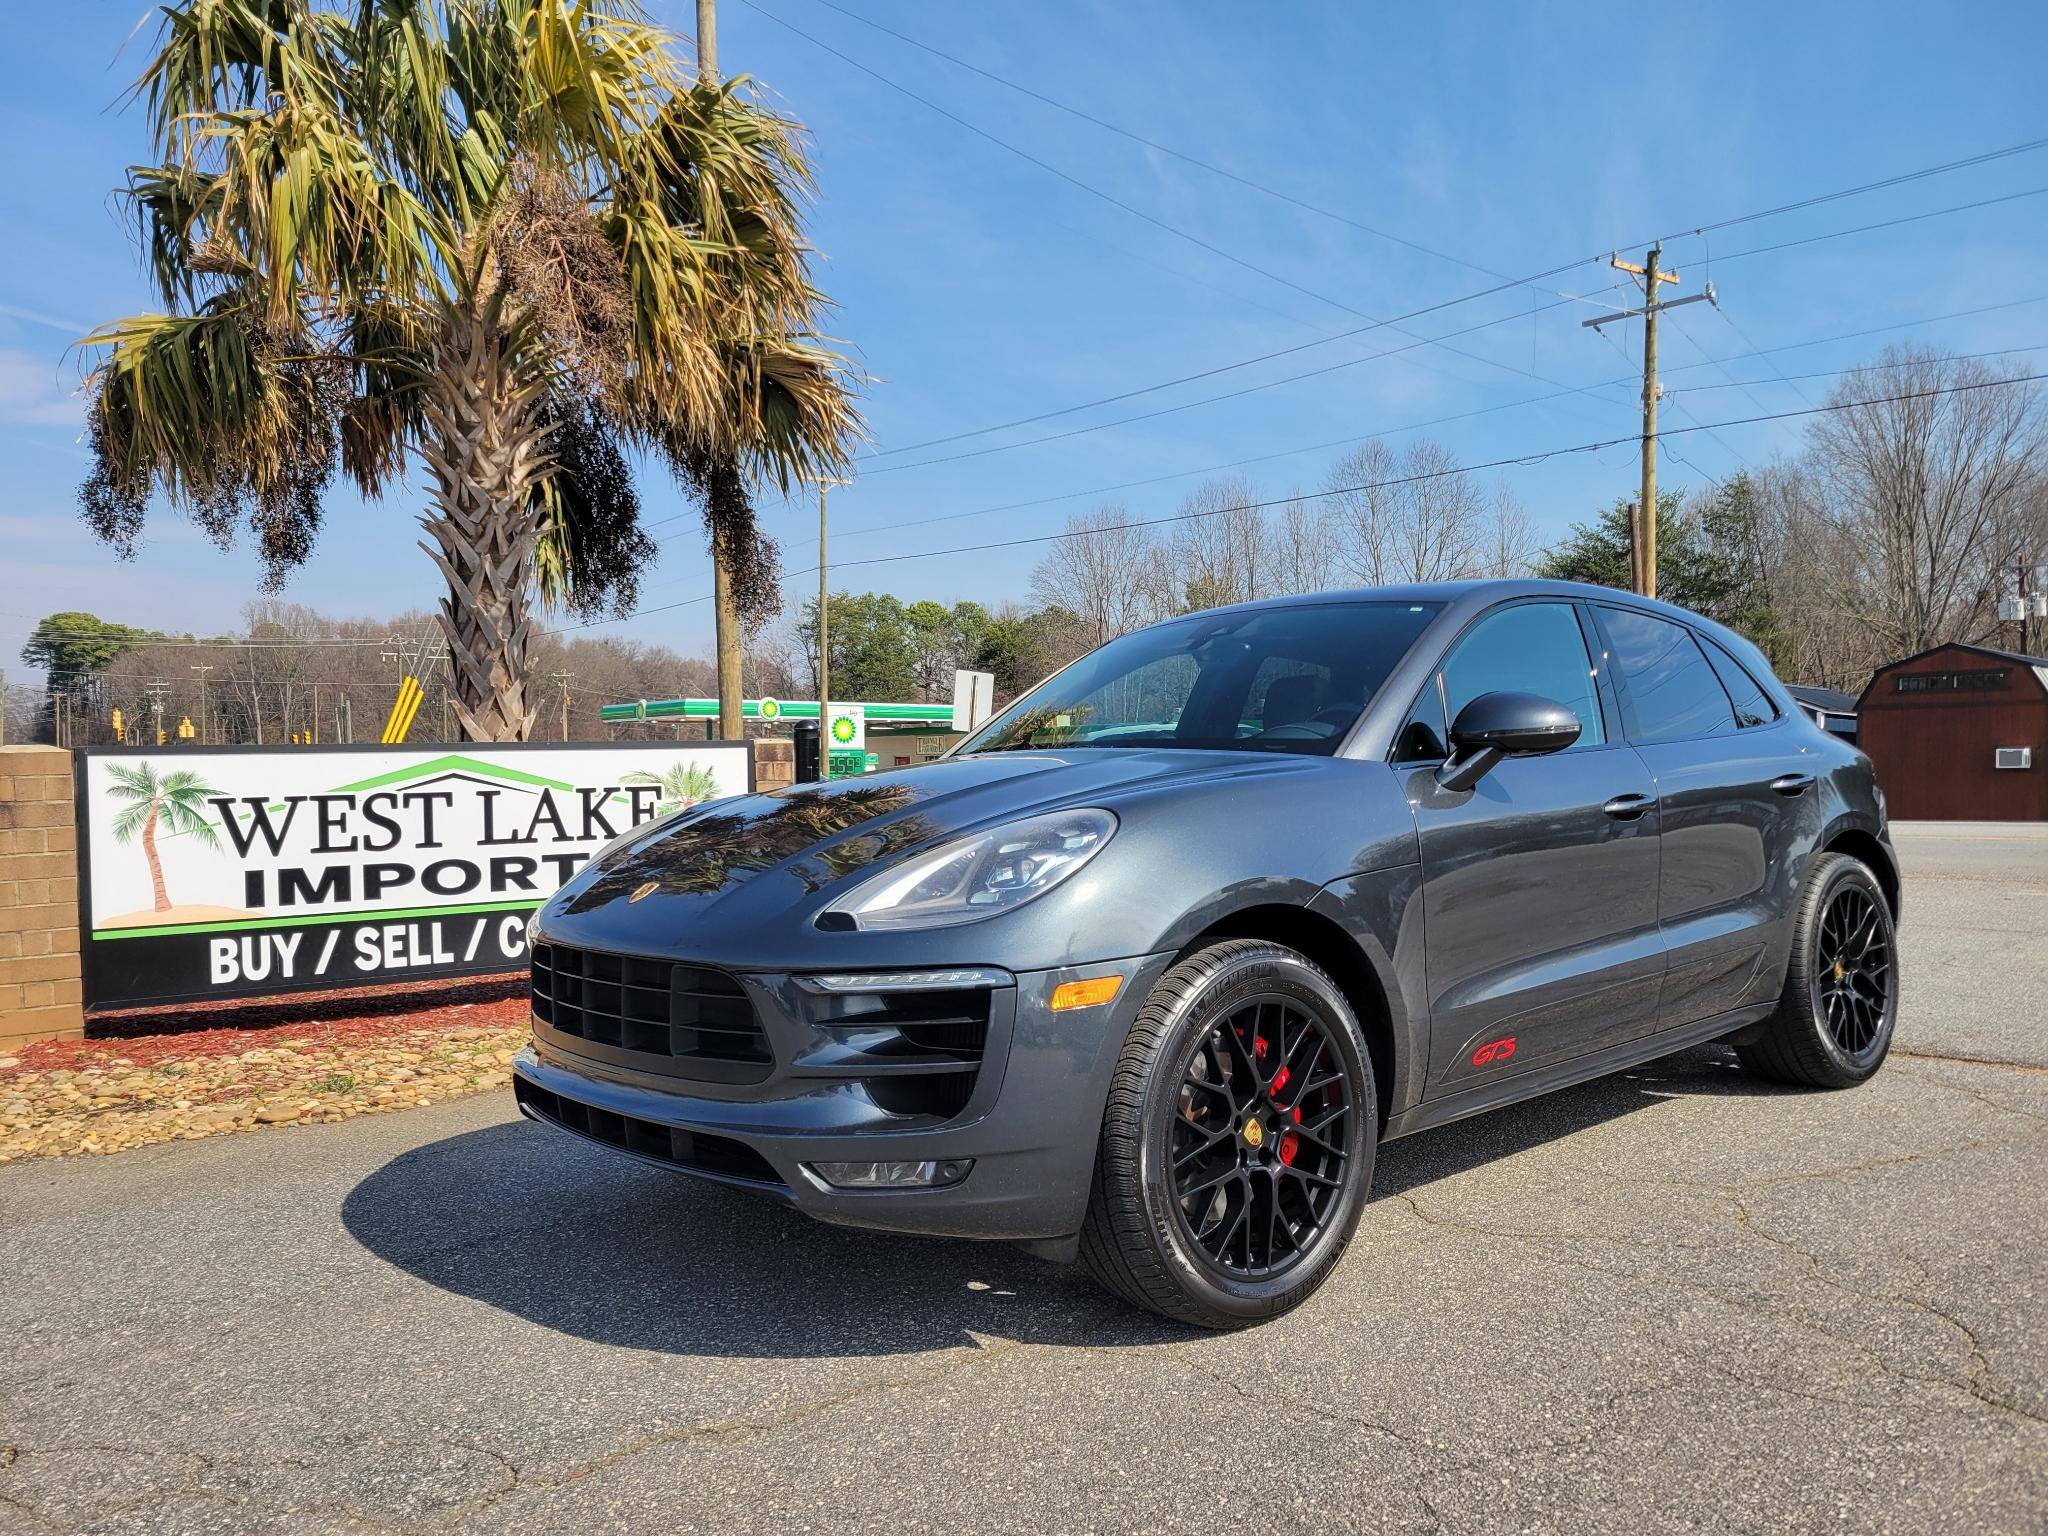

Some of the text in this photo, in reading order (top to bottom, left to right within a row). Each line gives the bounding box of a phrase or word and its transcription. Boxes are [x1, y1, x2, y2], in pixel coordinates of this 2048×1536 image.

[208, 786, 662, 858] WEST LAKE
[244, 853, 590, 908] IMPORT
[210, 931, 301, 985] BUY
[354, 923, 454, 970] SELL
[1203, 962, 1277, 1008] MICHELIN
[1472, 1036, 1517, 1066] GTS
